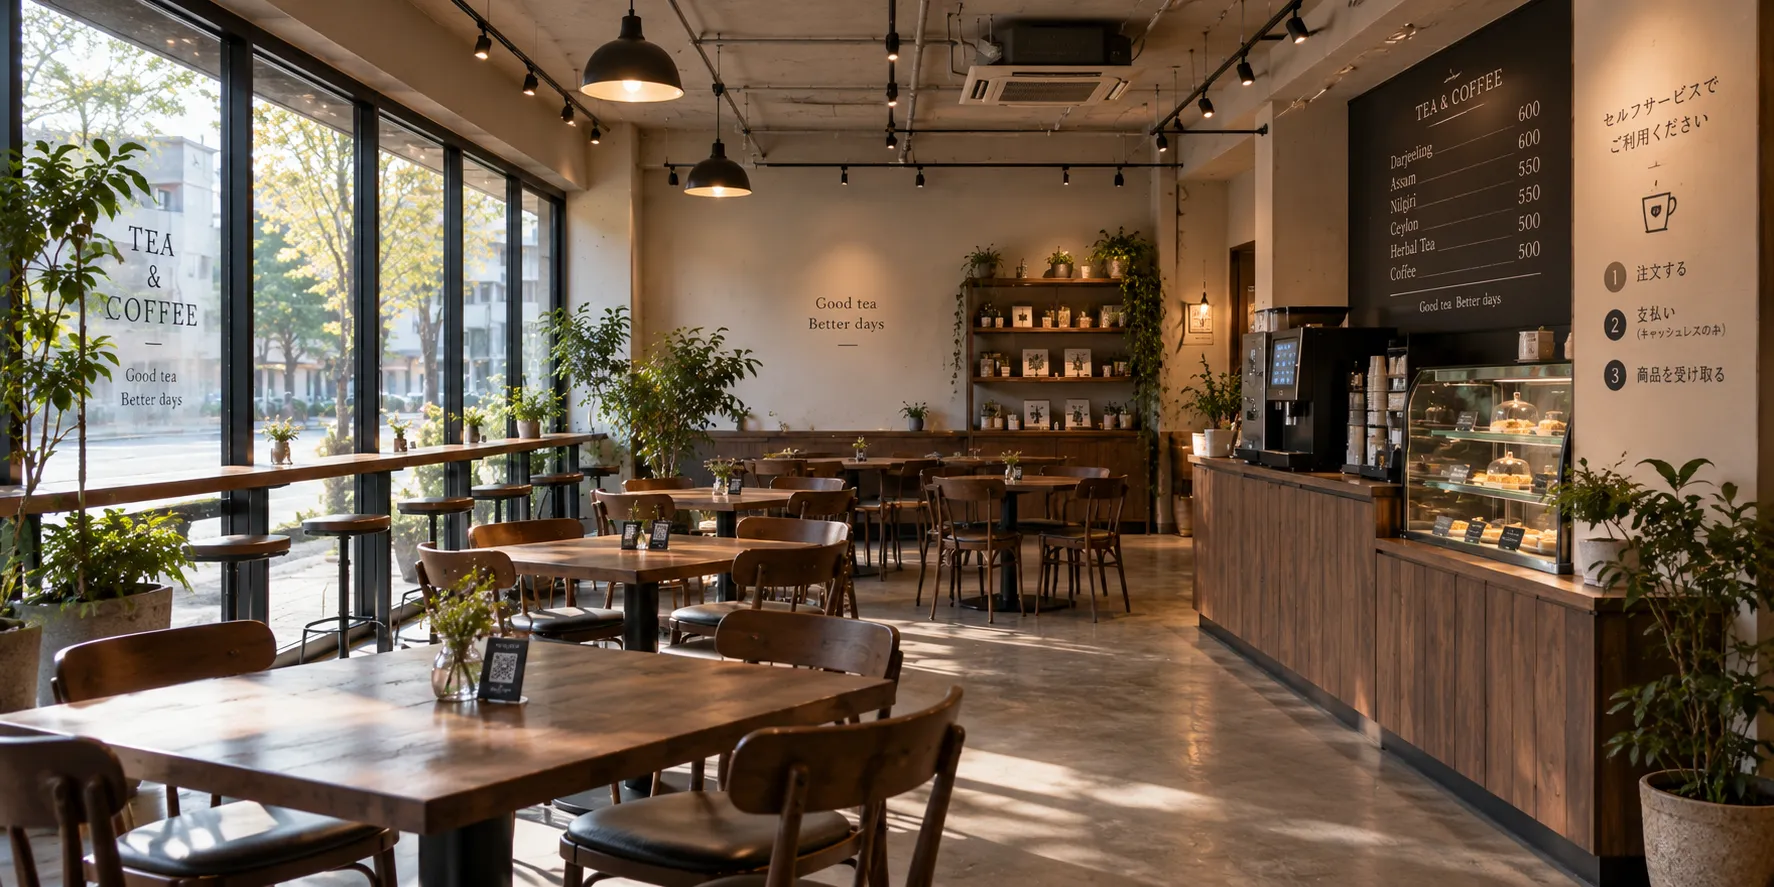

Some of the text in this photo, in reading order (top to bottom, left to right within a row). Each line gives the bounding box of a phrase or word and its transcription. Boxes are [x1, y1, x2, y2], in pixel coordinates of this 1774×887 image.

[1415, 68, 1503, 121] TEA & COFFEE
[1603, 75, 1719, 127] セルフサービスで
[1390, 100, 1540, 170] Darjeeling 600
[1610, 114, 1709, 154] ご利用ください
[1390, 128, 1540, 191] Assam 600
[1390, 156, 1540, 214] Nilgiri 550
[1390, 184, 1540, 238] Ceylon 550
[128, 225, 175, 257] TEA
[1390, 212, 1540, 259] Herbal Tea 500
[147, 264, 161, 289] &
[1390, 240, 1540, 282] Coffee 500
[1636, 260, 1687, 283] 注文する
[105, 295, 198, 327] COFFEE
[815, 296, 877, 309] Good tea
[1419, 292, 1502, 313] Good tea Better days
[809, 317, 885, 332] Better days
[1611, 305, 1676, 333] 2 支払い
[125, 367, 177, 383] Good tea
[1611, 366, 1725, 384] 3 商品を受け取る
[121, 391, 183, 409] Better days
